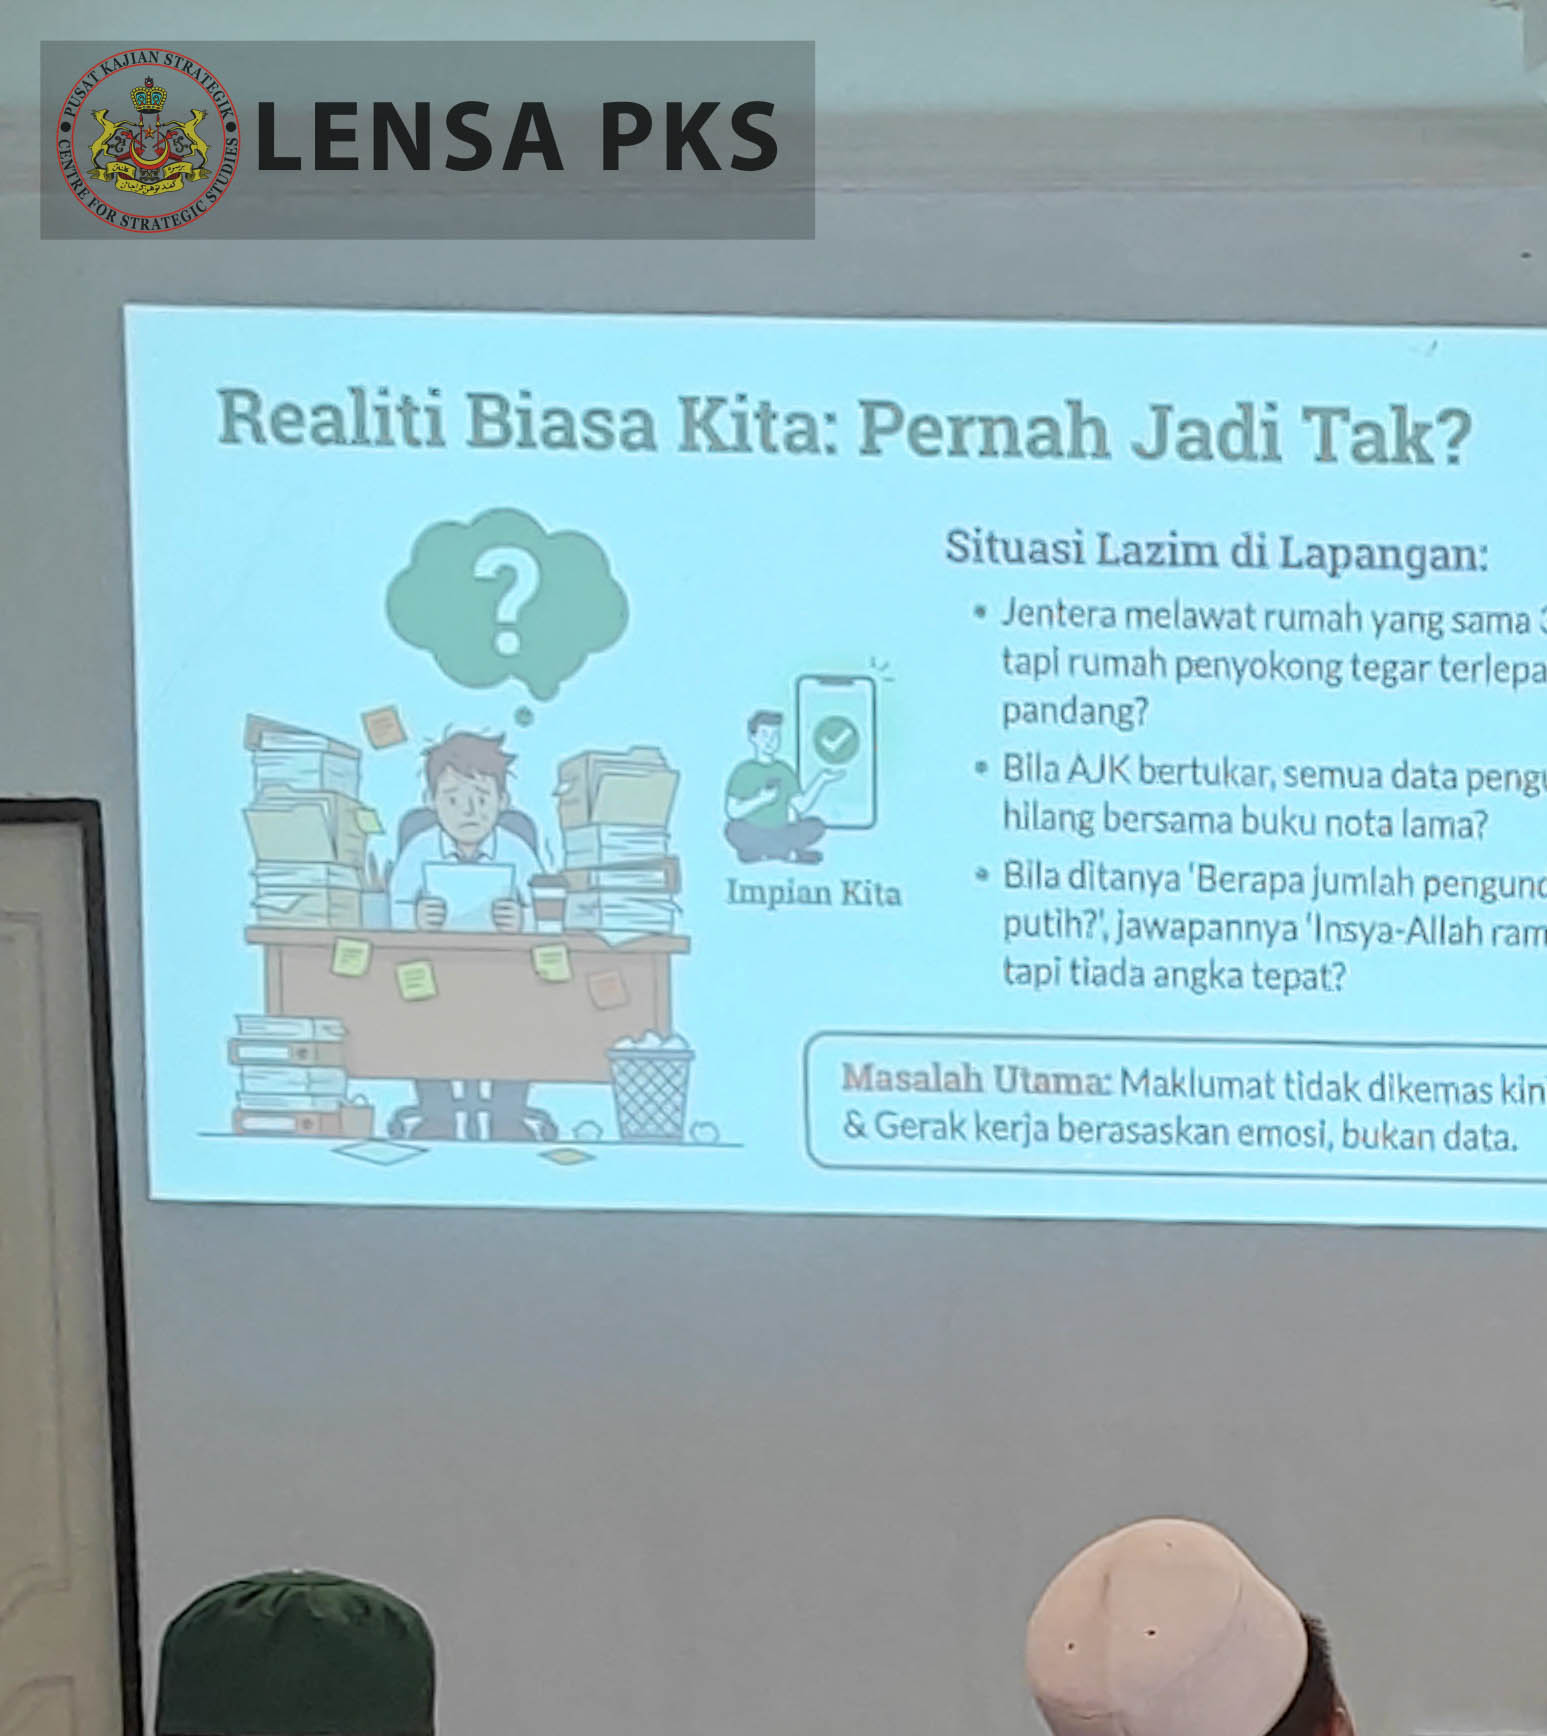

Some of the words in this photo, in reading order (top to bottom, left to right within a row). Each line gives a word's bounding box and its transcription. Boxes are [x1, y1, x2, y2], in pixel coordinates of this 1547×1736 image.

[217, 386, 445, 447] Realiti
[465, 390, 658, 451] Biasa
[678, 393, 838, 454] Kita:
[858, 398, 1112, 461] Pernah
[1130, 401, 1282, 464] Jadi
[1302, 403, 1473, 466] Tak?
[947, 527, 1086, 565] Situasi
[1097, 529, 1220, 568] Lazim
[1231, 531, 1270, 569] di
[1279, 534, 1489, 580] Lapangan:
[1001, 596, 1117, 628] Jentera
[1126, 597, 1256, 632] melawat
[1264, 601, 1363, 633] rumah
[1370, 608, 1443, 641] yang
[1452, 609, 1531, 635] sama
[1002, 645, 1060, 682] tapi
[1068, 645, 1168, 678] rumah
[1175, 649, 1343, 689] penyokong
[1351, 652, 1433, 690] tegar
[1002, 694, 1150, 733] pandang?
[1002, 751, 1060, 783] Bila
[1067, 753, 1132, 784] AJK
[1139, 754, 1277, 792] bertukar,
[1283, 764, 1383, 790] semua
[1391, 757, 1458, 791] data
[1002, 799, 1096, 839] hilang
[1104, 800, 1233, 834] bersama
[1241, 803, 1316, 836] buku
[1325, 808, 1394, 838] nota
[1402, 806, 1489, 841] lama?
[725, 876, 832, 912] Impian
[840, 879, 903, 908] Kita
[1002, 859, 1060, 891] Bila
[1068, 859, 1181, 899] ditanya
[1310, 862, 1414, 902] jumlah
[1114, 908, 1298, 948] jawapannya
[1002, 955, 1062, 992] tapi
[1069, 955, 1145, 989] tiada
[1153, 956, 1244, 996] angka
[1252, 959, 1347, 998] tepat?
[841, 1061, 984, 1094] Masalah
[994, 1063, 1114, 1097] Utama:
[1120, 1066, 1276, 1101] Maklumat
[1285, 1068, 1363, 1103] tidak
[1368, 1071, 1494, 1106] dikemas
[843, 1109, 868, 1140] &
[875, 1109, 968, 1142] Gerak
[974, 1109, 1050, 1149] kerja
[1058, 1112, 1230, 1147] berasaskan
[1238, 1118, 1335, 1153] emosi,
[1342, 1117, 1436, 1152] bukan
[1443, 1119, 1518, 1153] data.
